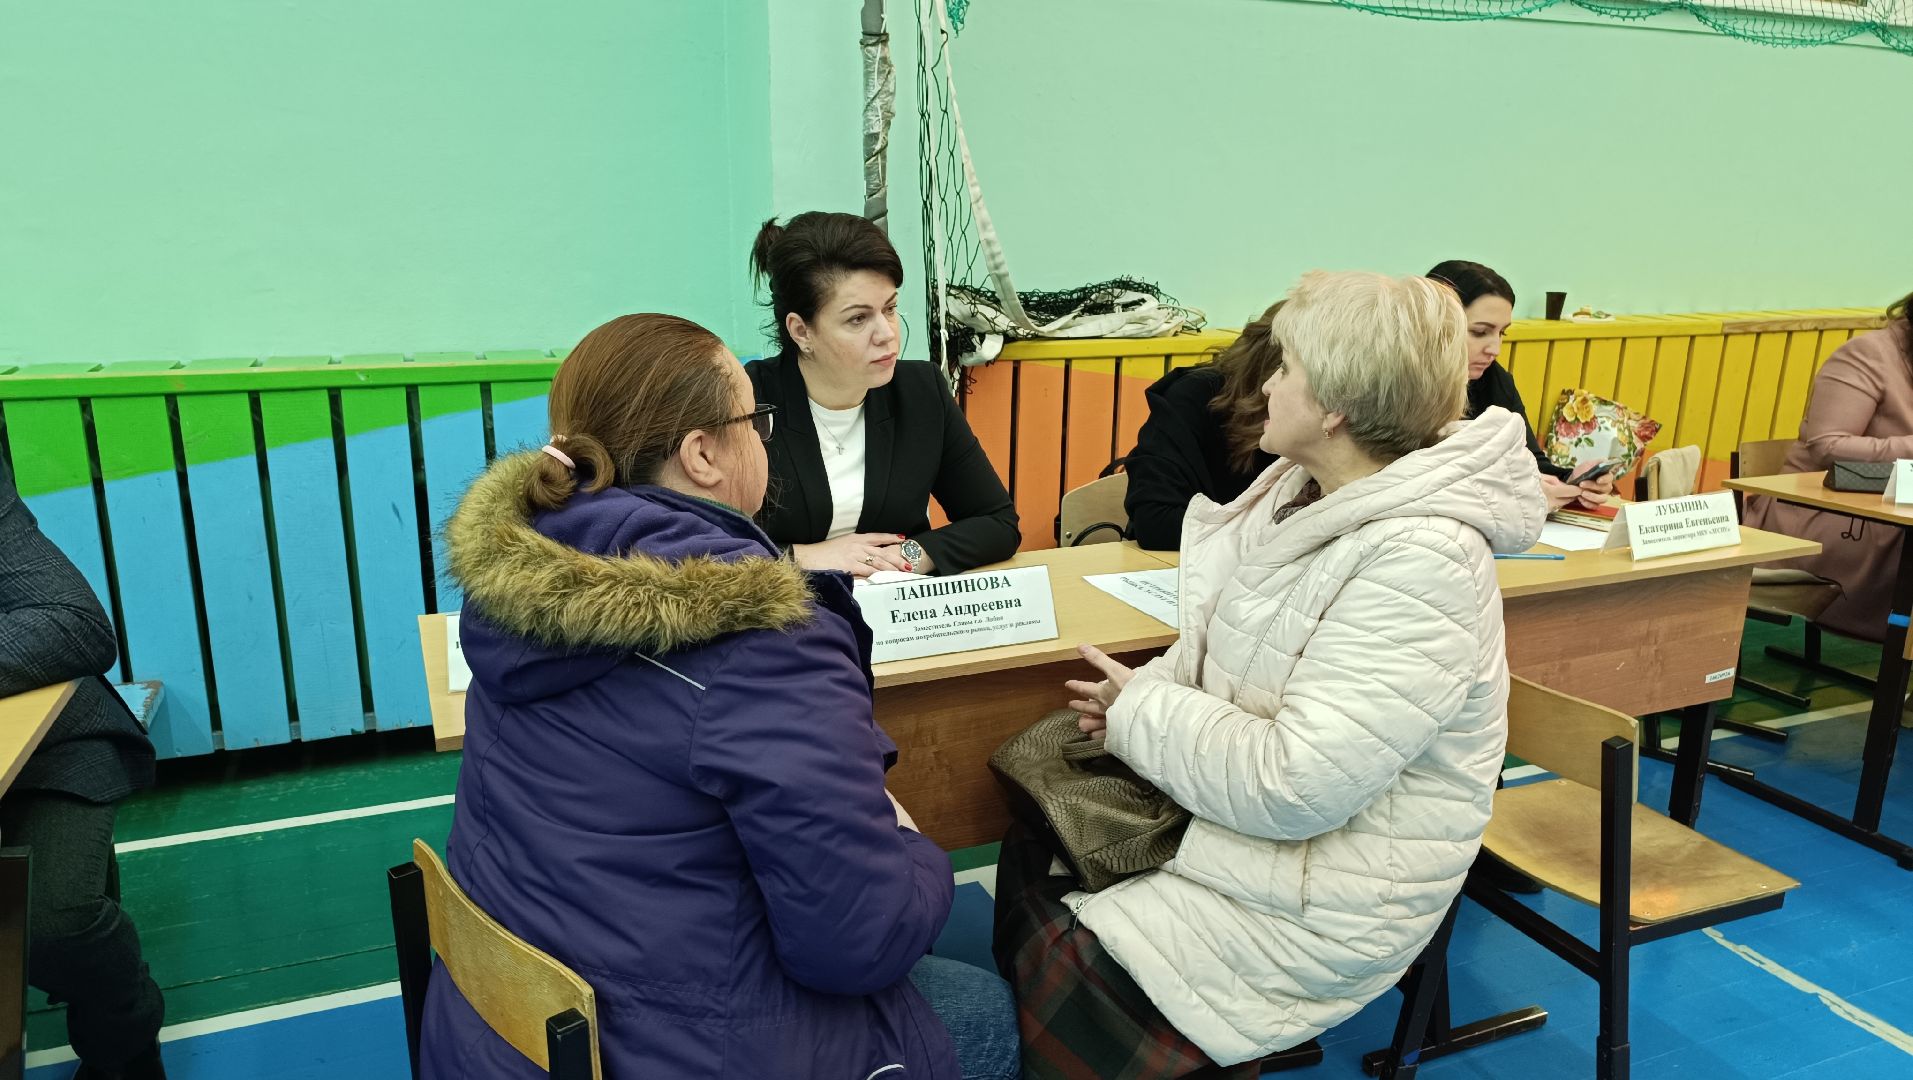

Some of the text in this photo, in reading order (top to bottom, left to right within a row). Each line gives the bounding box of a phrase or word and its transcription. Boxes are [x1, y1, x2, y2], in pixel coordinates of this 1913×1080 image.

[1655, 499, 1710, 517] ЛУБЕНИНА
[1638, 514, 1730, 535] Екатерина Евгеньевна
[894, 575, 1012, 601] ЛАПШИНОВА
[890, 597, 1022, 624] Елена Андреевна
